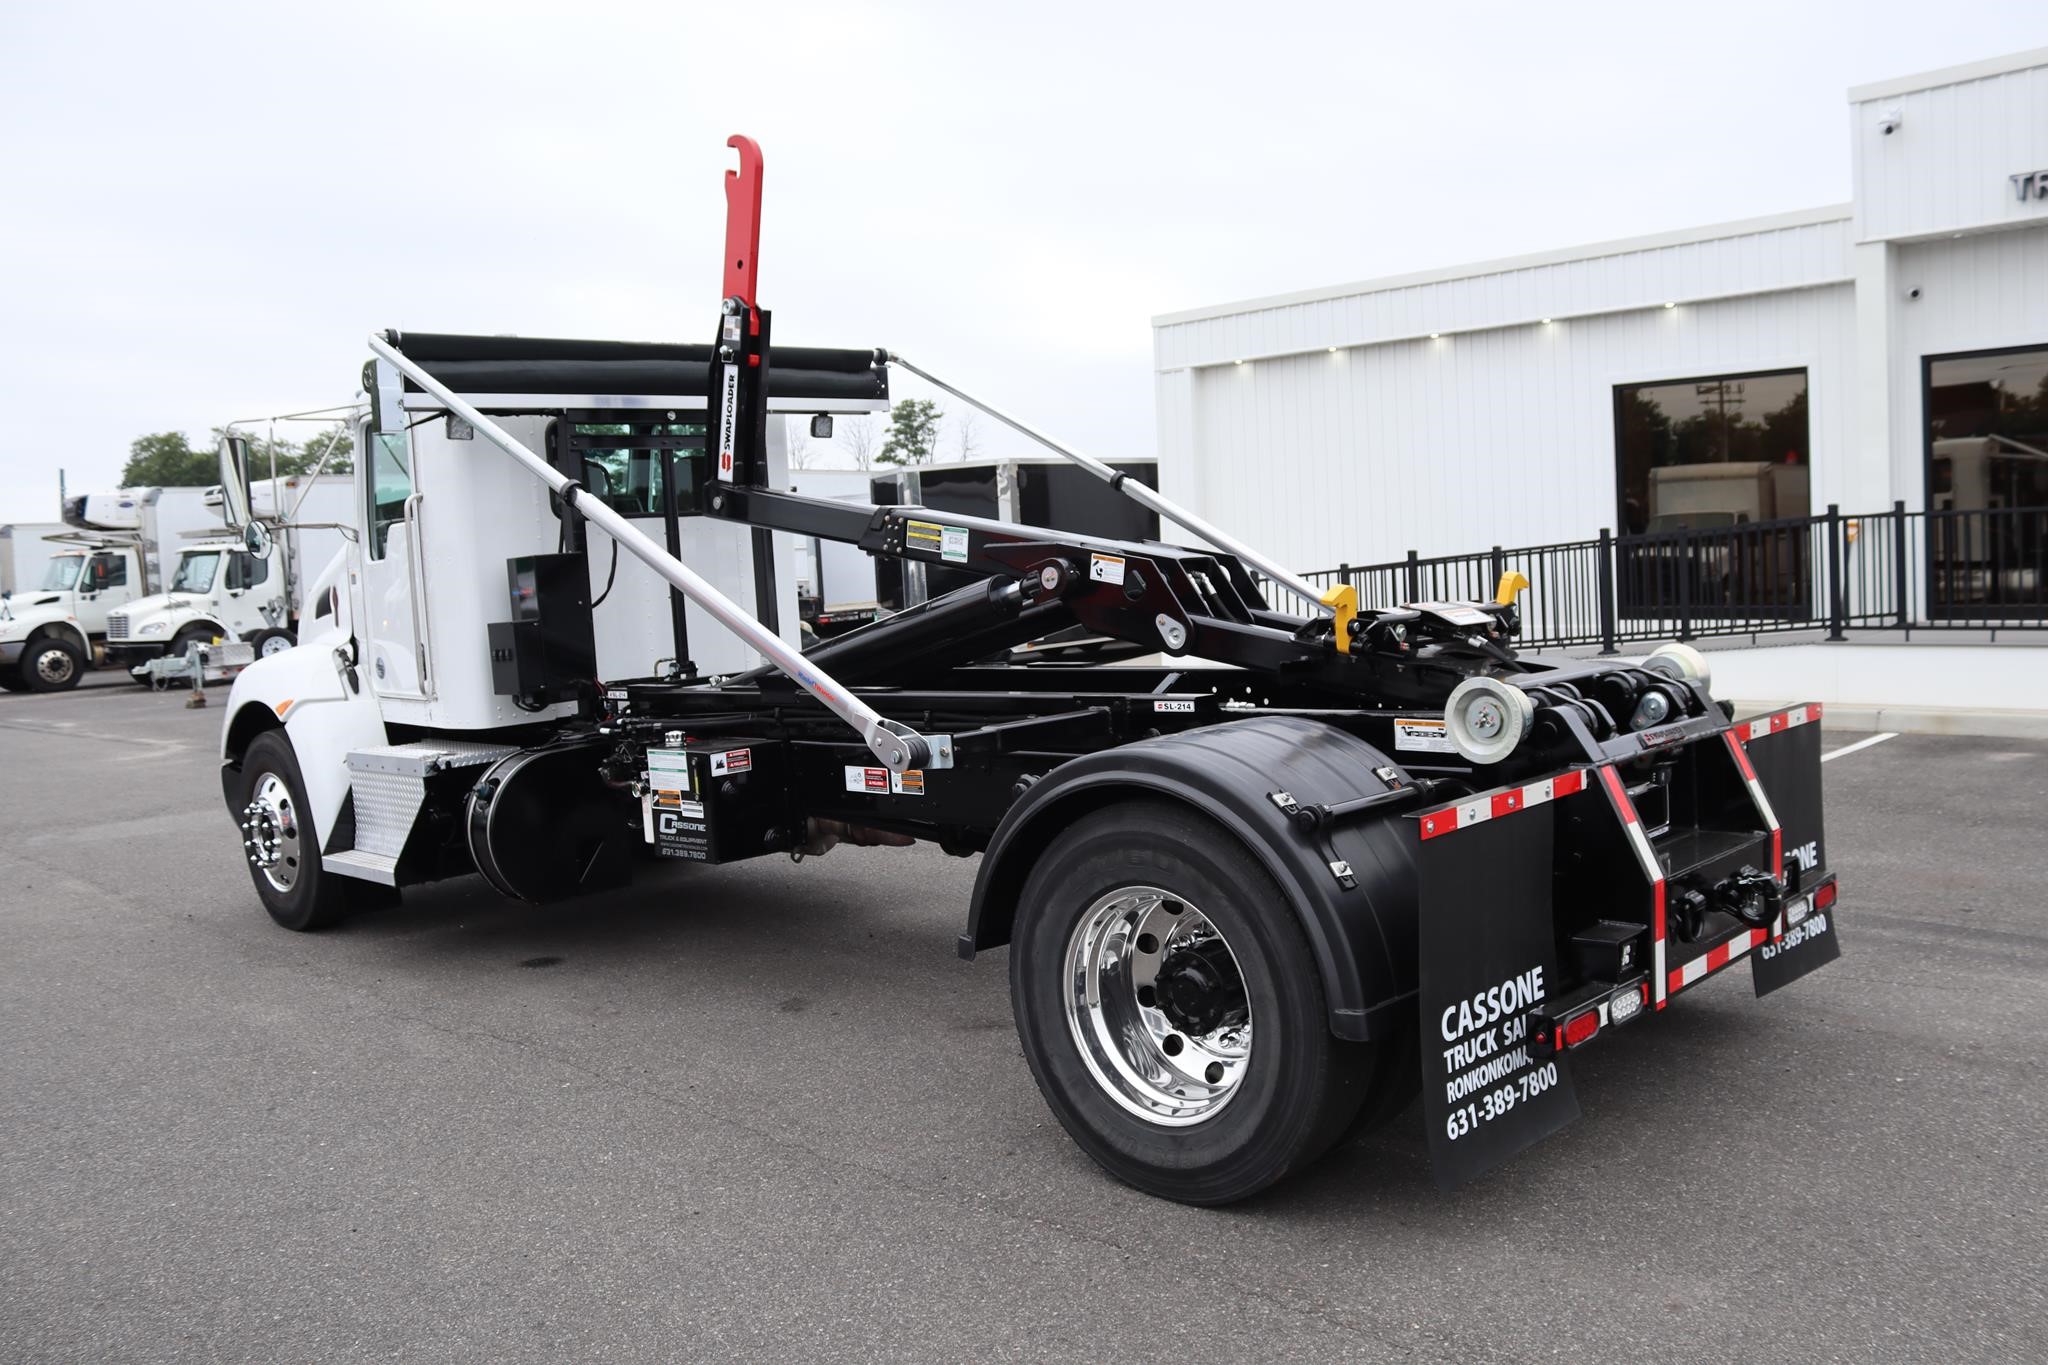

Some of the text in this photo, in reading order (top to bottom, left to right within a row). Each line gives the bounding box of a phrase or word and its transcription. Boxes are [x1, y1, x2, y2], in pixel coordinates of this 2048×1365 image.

[724, 374, 735, 450] SWAPLOADER
[660, 813, 706, 834] CASSONE
[1441, 965, 1545, 1042] CASSONE
[1443, 1028, 1500, 1074] TRUCK
[1446, 1062, 1558, 1141] 631-389-7800
